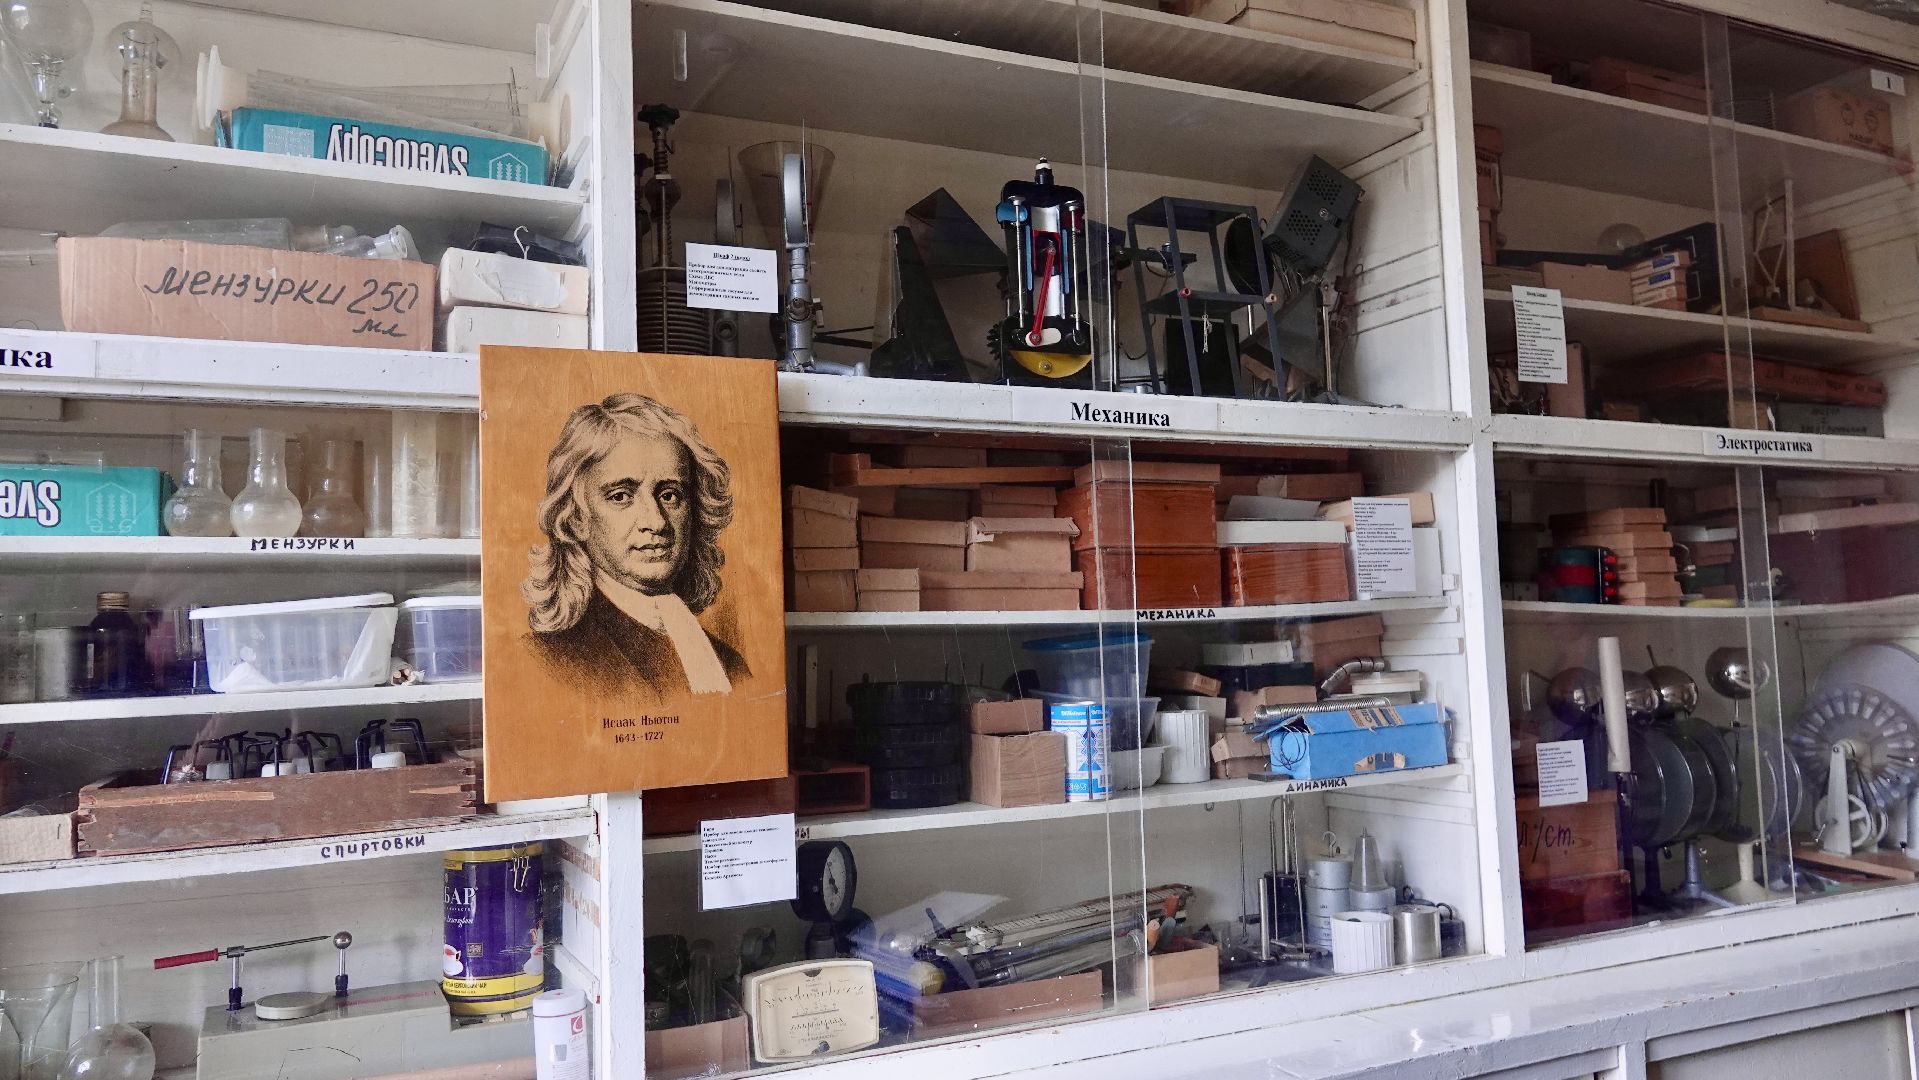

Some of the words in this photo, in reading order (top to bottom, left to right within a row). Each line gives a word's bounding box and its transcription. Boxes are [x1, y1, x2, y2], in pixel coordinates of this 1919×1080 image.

[346, 279, 420, 314] 250
[1070, 402, 1171, 427] Механика
[1716, 434, 1813, 454] Электростатика
[250, 538, 354, 551] МЕНЗУРКИ
[1136, 608, 1216, 621] МЕХАНИКА
[603, 718, 636, 729] Исаак
[641, 715, 680, 726] Ньютон
[1286, 777, 1348, 792] ДИНАМИКА
